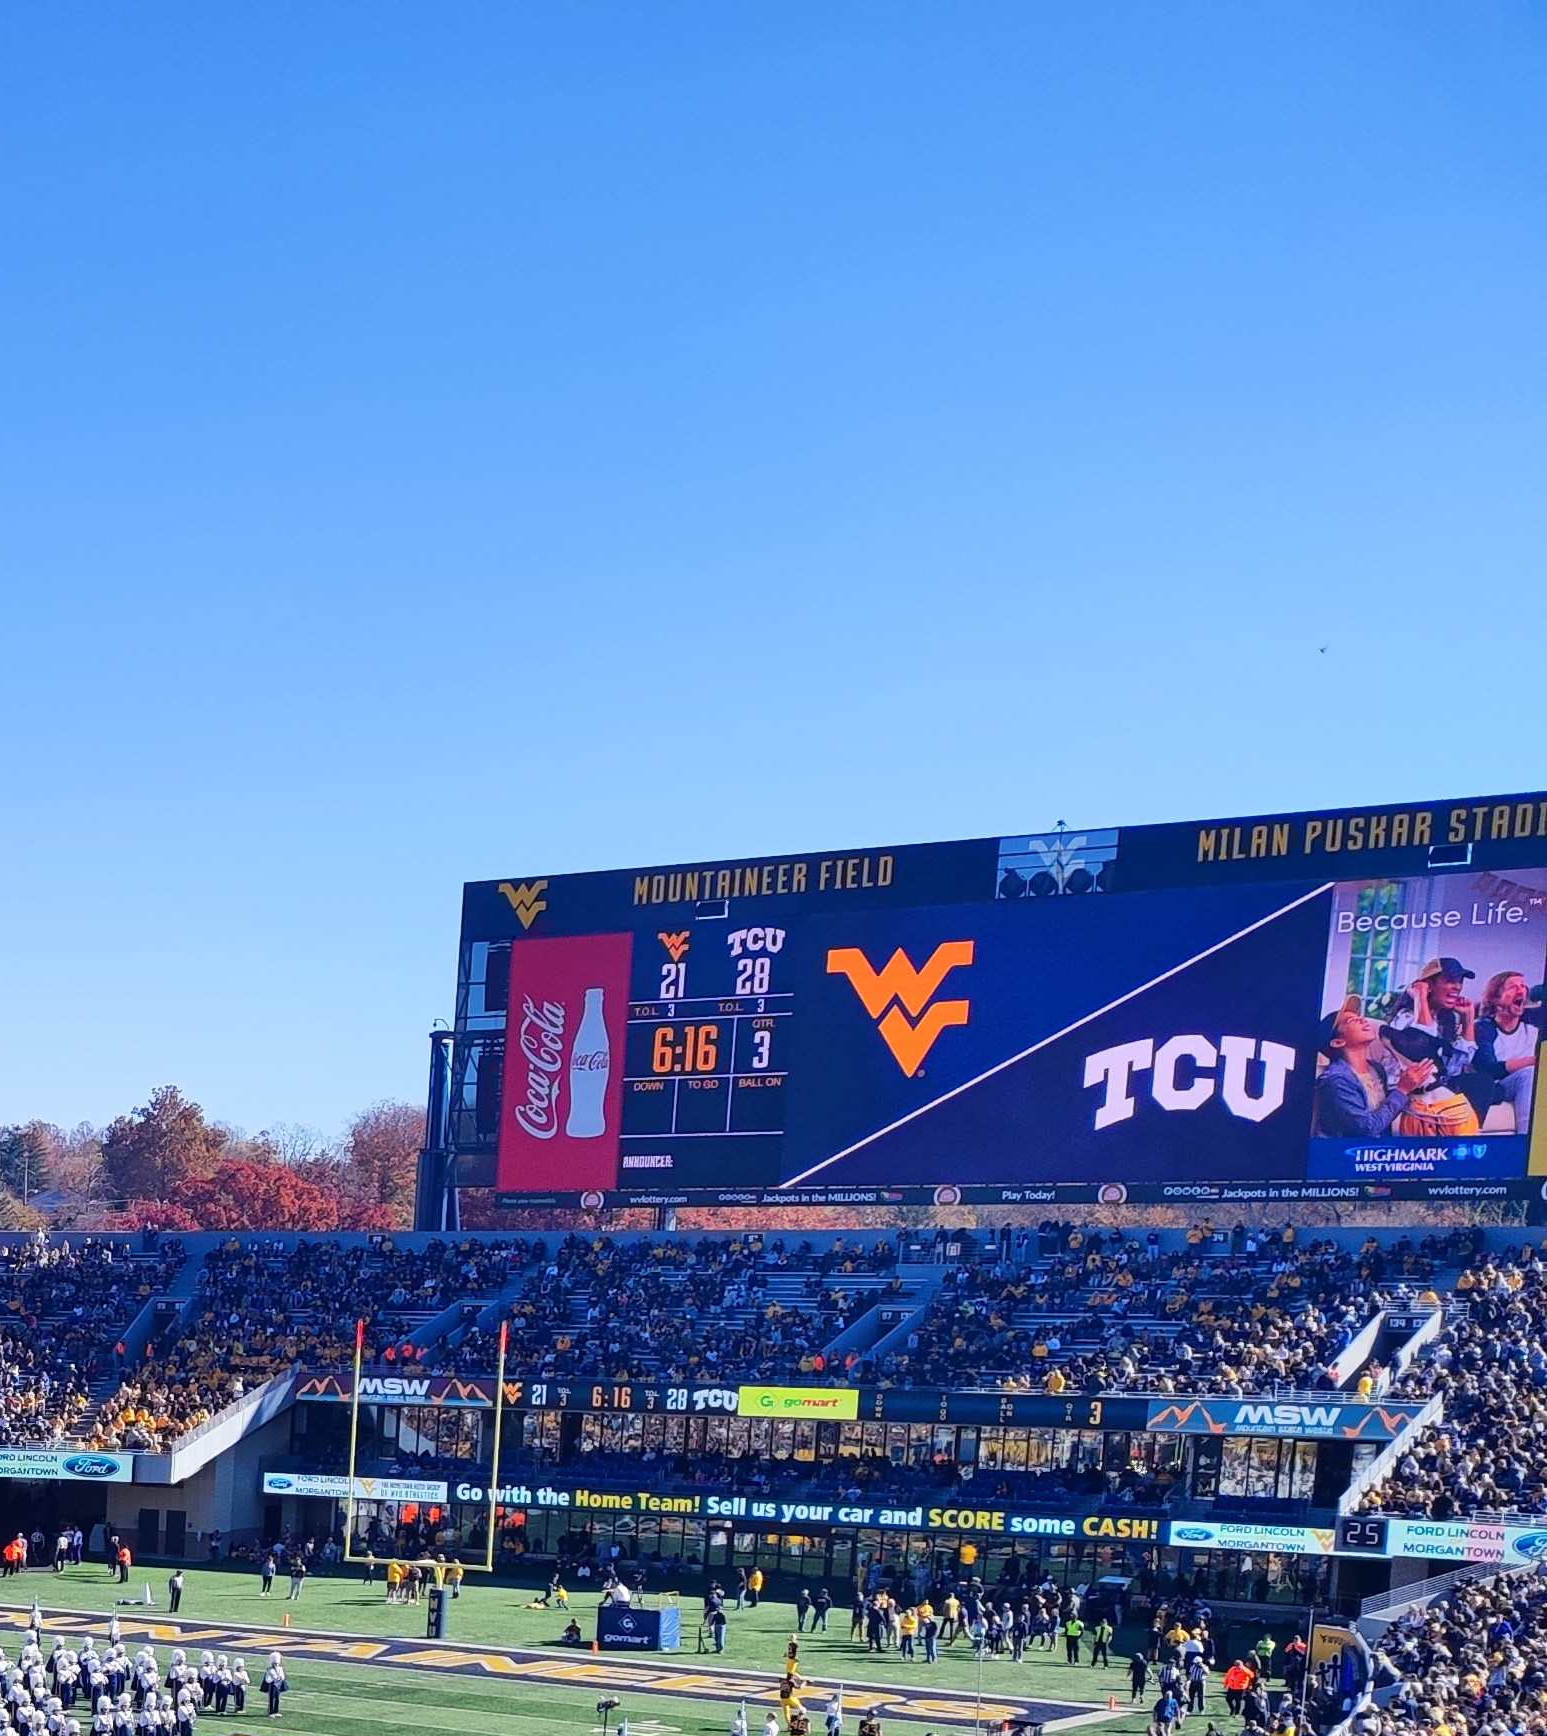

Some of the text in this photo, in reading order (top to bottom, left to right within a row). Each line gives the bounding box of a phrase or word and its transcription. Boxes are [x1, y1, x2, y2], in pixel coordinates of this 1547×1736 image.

[1198, 824, 1290, 862] MILAN
[1304, 811, 1433, 856] PUSKAR
[633, 855, 894, 905] MOUNTAINEER FIELD
[1338, 905, 1461, 934] Because
[727, 928, 786, 957] TCU
[660, 963, 686, 999] 21
[736, 957, 771, 995] 28
[668, 1003, 675, 1017] 3
[757, 998, 765, 1012] 3
[652, 1025, 718, 1073] 6:16
[752, 1031, 771, 1069] 3
[515, 993, 566, 1139] Coca-Cola
[633, 1082, 664, 1092] DOWN
[687, 1080, 719, 1090] TO GO
[738, 1077, 781, 1088] BALL ON
[1083, 1034, 1296, 1131] TCU
[1355, 1147, 1448, 1162] HIGHMARK
[1355, 1162, 1435, 1172] WEST VIRGINIA
[762, 1193, 800, 1203] Jackpots
[802, 1194, 813, 1202] in
[814, 1194, 826, 1202] the
[828, 1193, 877, 1202] MILLIONS!
[1002, 1190, 1056, 1201] Play Today!
[1222, 1187, 1360, 1199] Jackpots in the MILLIONS!
[1428, 1185, 1507, 1197] wvlottery.com
[630, 1195, 687, 1204] wvlottery.com
[358, 1378, 430, 1396] MSW
[532, 1385, 547, 1405] 21
[559, 1394, 567, 1407] 3
[592, 1386, 631, 1409] 6:16
[667, 1388, 738, 1411] 28 TCU
[783, 1397, 839, 1408] gomart
[647, 1396, 655, 1410] 3
[1089, 1401, 1102, 1425] 3
[1234, 1404, 1341, 1427] MSW
[18, 1454, 57, 1464] LINCOLN
[74, 1457, 108, 1475] Ford
[297, 1475, 318, 1483] FORD
[457, 1484, 1159, 1539] Go with the Home Team! Sell us your car and SCORE some CASH!
[1220, 1524, 1305, 1537] FORD LINCOLN
[1346, 1523, 1379, 1545] 25
[1407, 1525, 1505, 1541] FORD LINCOLN
[1217, 1540, 1305, 1551] MORGANTOWN
[1403, 1543, 1505, 1558] MORGANTOWN
[604, 1633, 652, 1646] gomart
